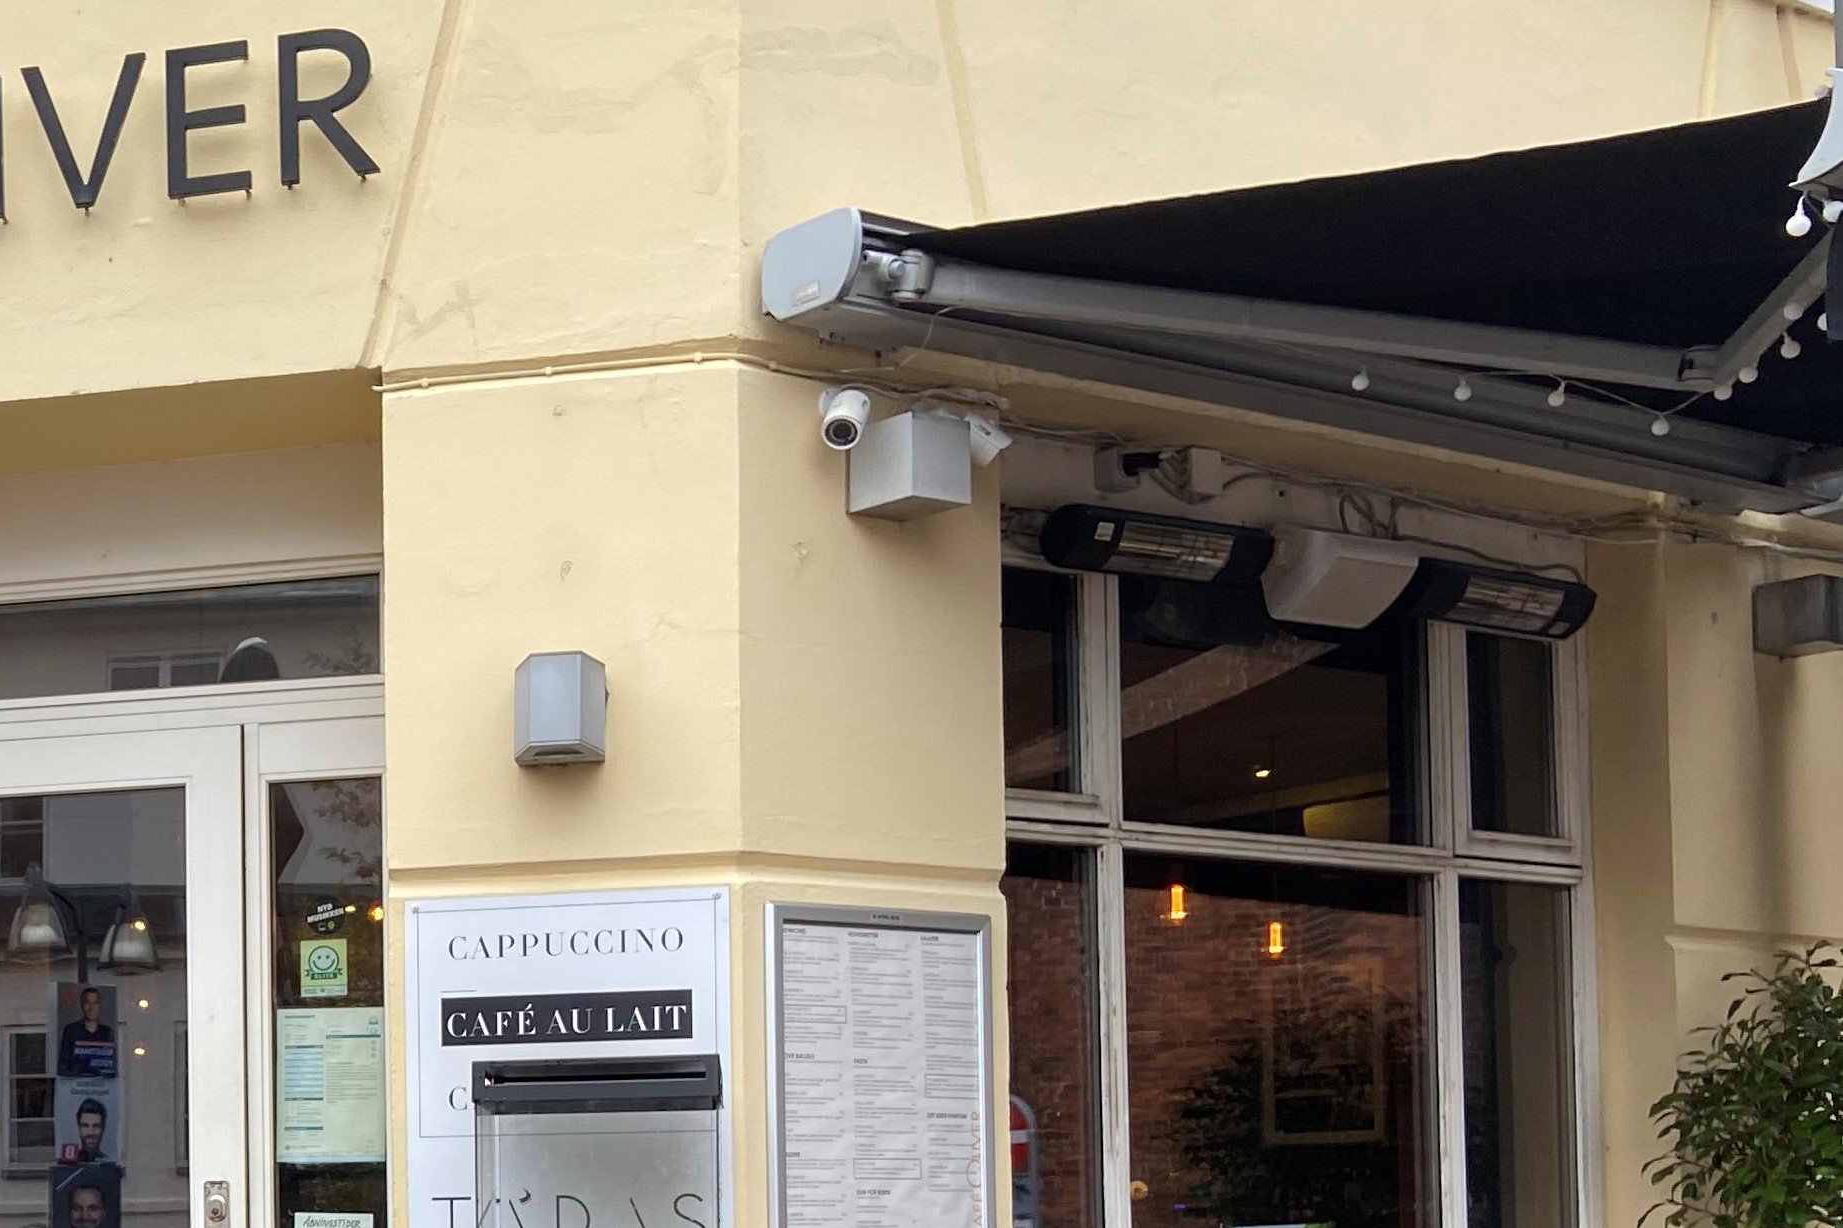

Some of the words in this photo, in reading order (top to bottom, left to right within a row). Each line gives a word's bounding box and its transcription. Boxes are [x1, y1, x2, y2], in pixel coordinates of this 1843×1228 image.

[448, 927, 684, 961] CAPPUCCINO
[447, 1003, 536, 1038] CAFÉ
[545, 1008, 593, 1034] AU
[605, 1005, 687, 1032] LAIT
